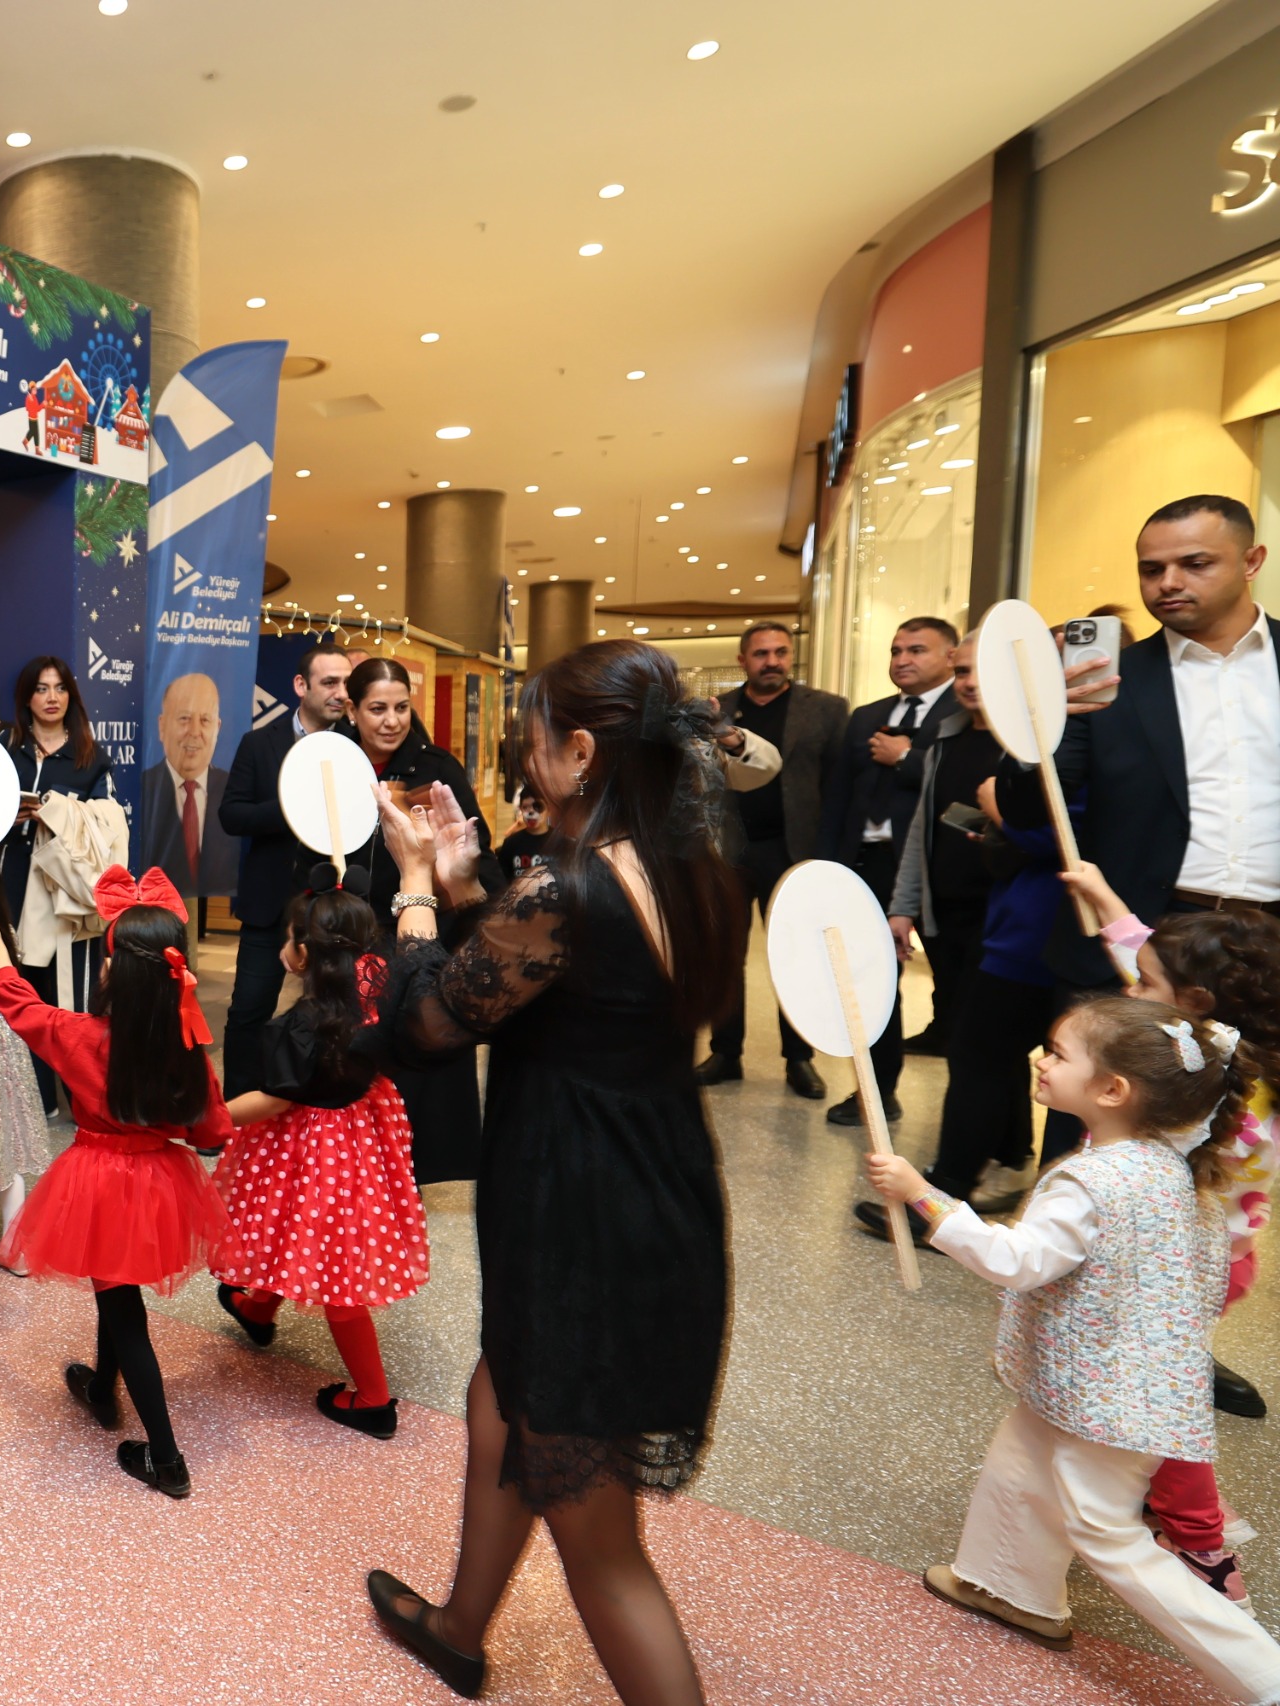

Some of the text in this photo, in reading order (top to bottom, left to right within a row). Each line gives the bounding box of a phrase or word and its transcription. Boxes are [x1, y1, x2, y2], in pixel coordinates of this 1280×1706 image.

[209, 575, 241, 589] Yüreğir
[192, 586, 238, 600] Belediyesi
[157, 611, 252, 635] Ali Demirçalı
[157, 632, 250, 648] Yüreğir Belediye Başkanı
[111, 658, 135, 673] Yüreğir
[101, 668, 133, 684] Belediyesi
[88, 720, 136, 741] MUTLU
